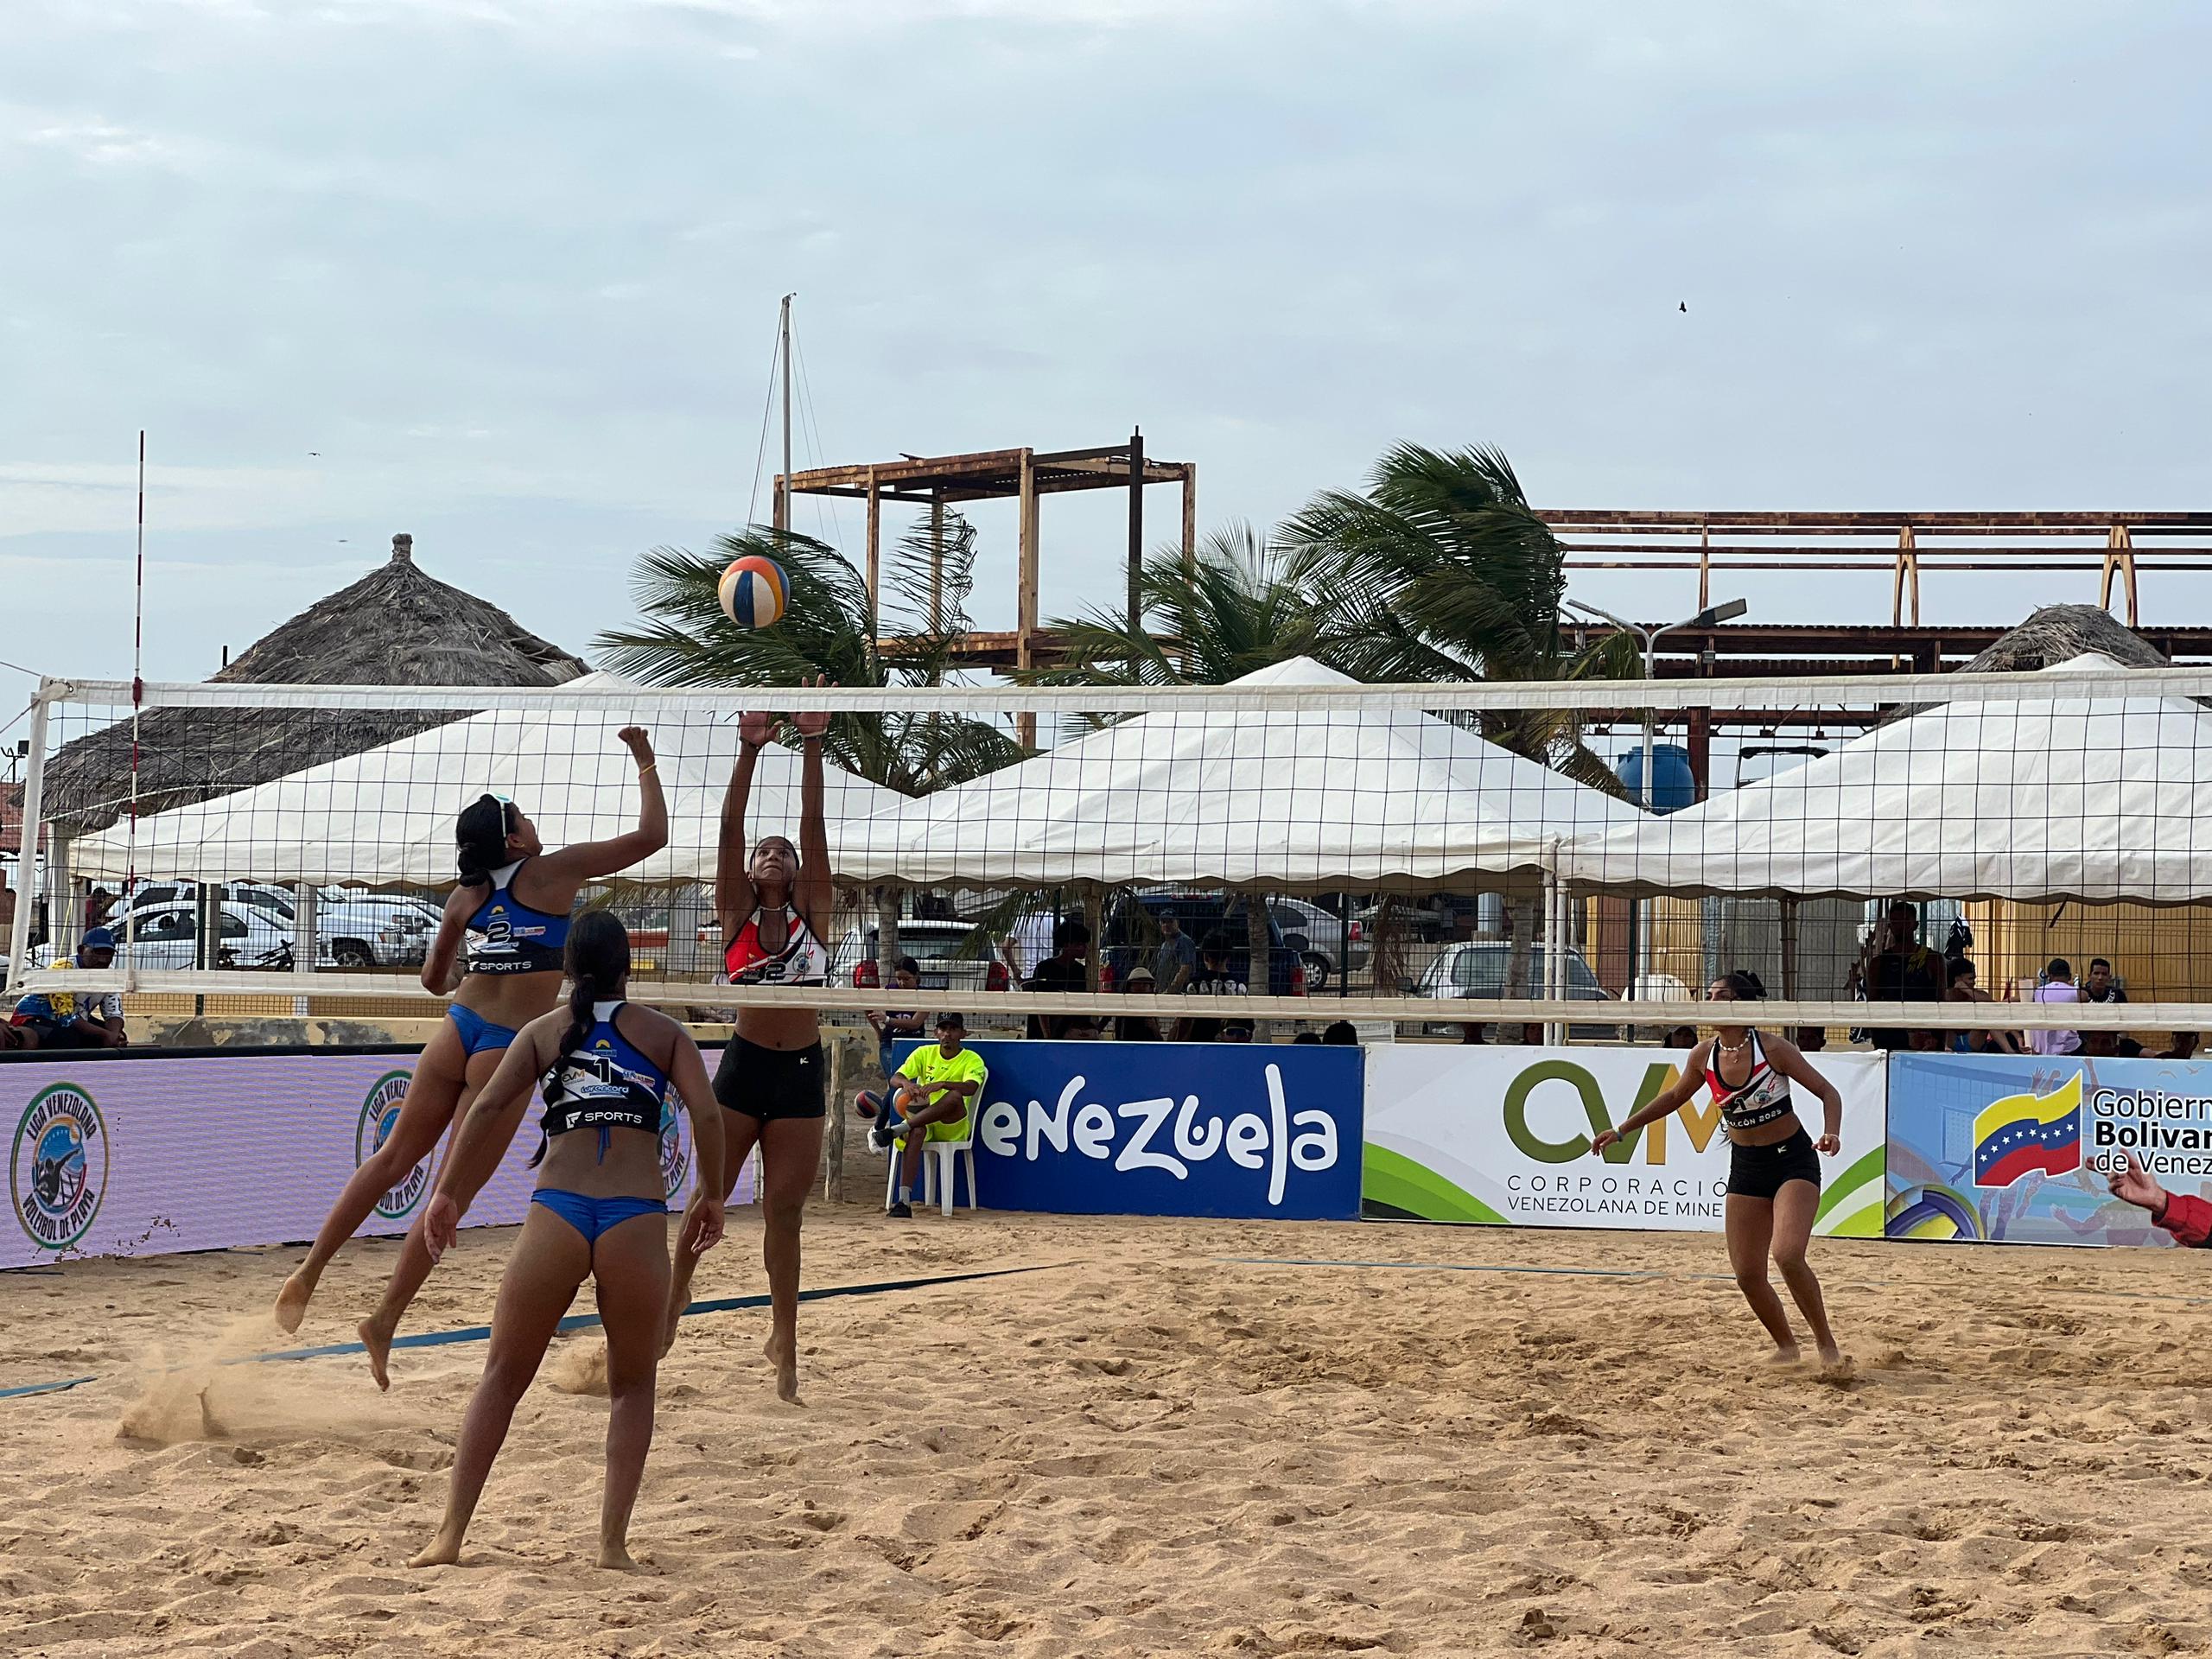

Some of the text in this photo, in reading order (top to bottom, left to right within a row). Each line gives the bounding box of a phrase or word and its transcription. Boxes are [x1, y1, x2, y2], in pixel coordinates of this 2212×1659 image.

[486, 921, 512, 944] 2
[480, 961, 532, 971] SPORTS
[765, 962, 786, 981] 2
[594, 1058, 610, 1084] 1
[27, 1092, 98, 1141] LIGA VENEZOLANA
[369, 1090, 386, 1122] LIGA
[1503, 1059, 1723, 1166] CVM
[584, 1111, 643, 1125] SPORTS
[2095, 1149, 2127, 1172] de
[403, 1164, 425, 1204] PLAYA
[1508, 1175, 1727, 1198] CORPORACIÓ
[22, 1187, 96, 1241] VOLEIBOL DE PLAYA
[1508, 1196, 1723, 1217] VENEZOLANA DE MINE
